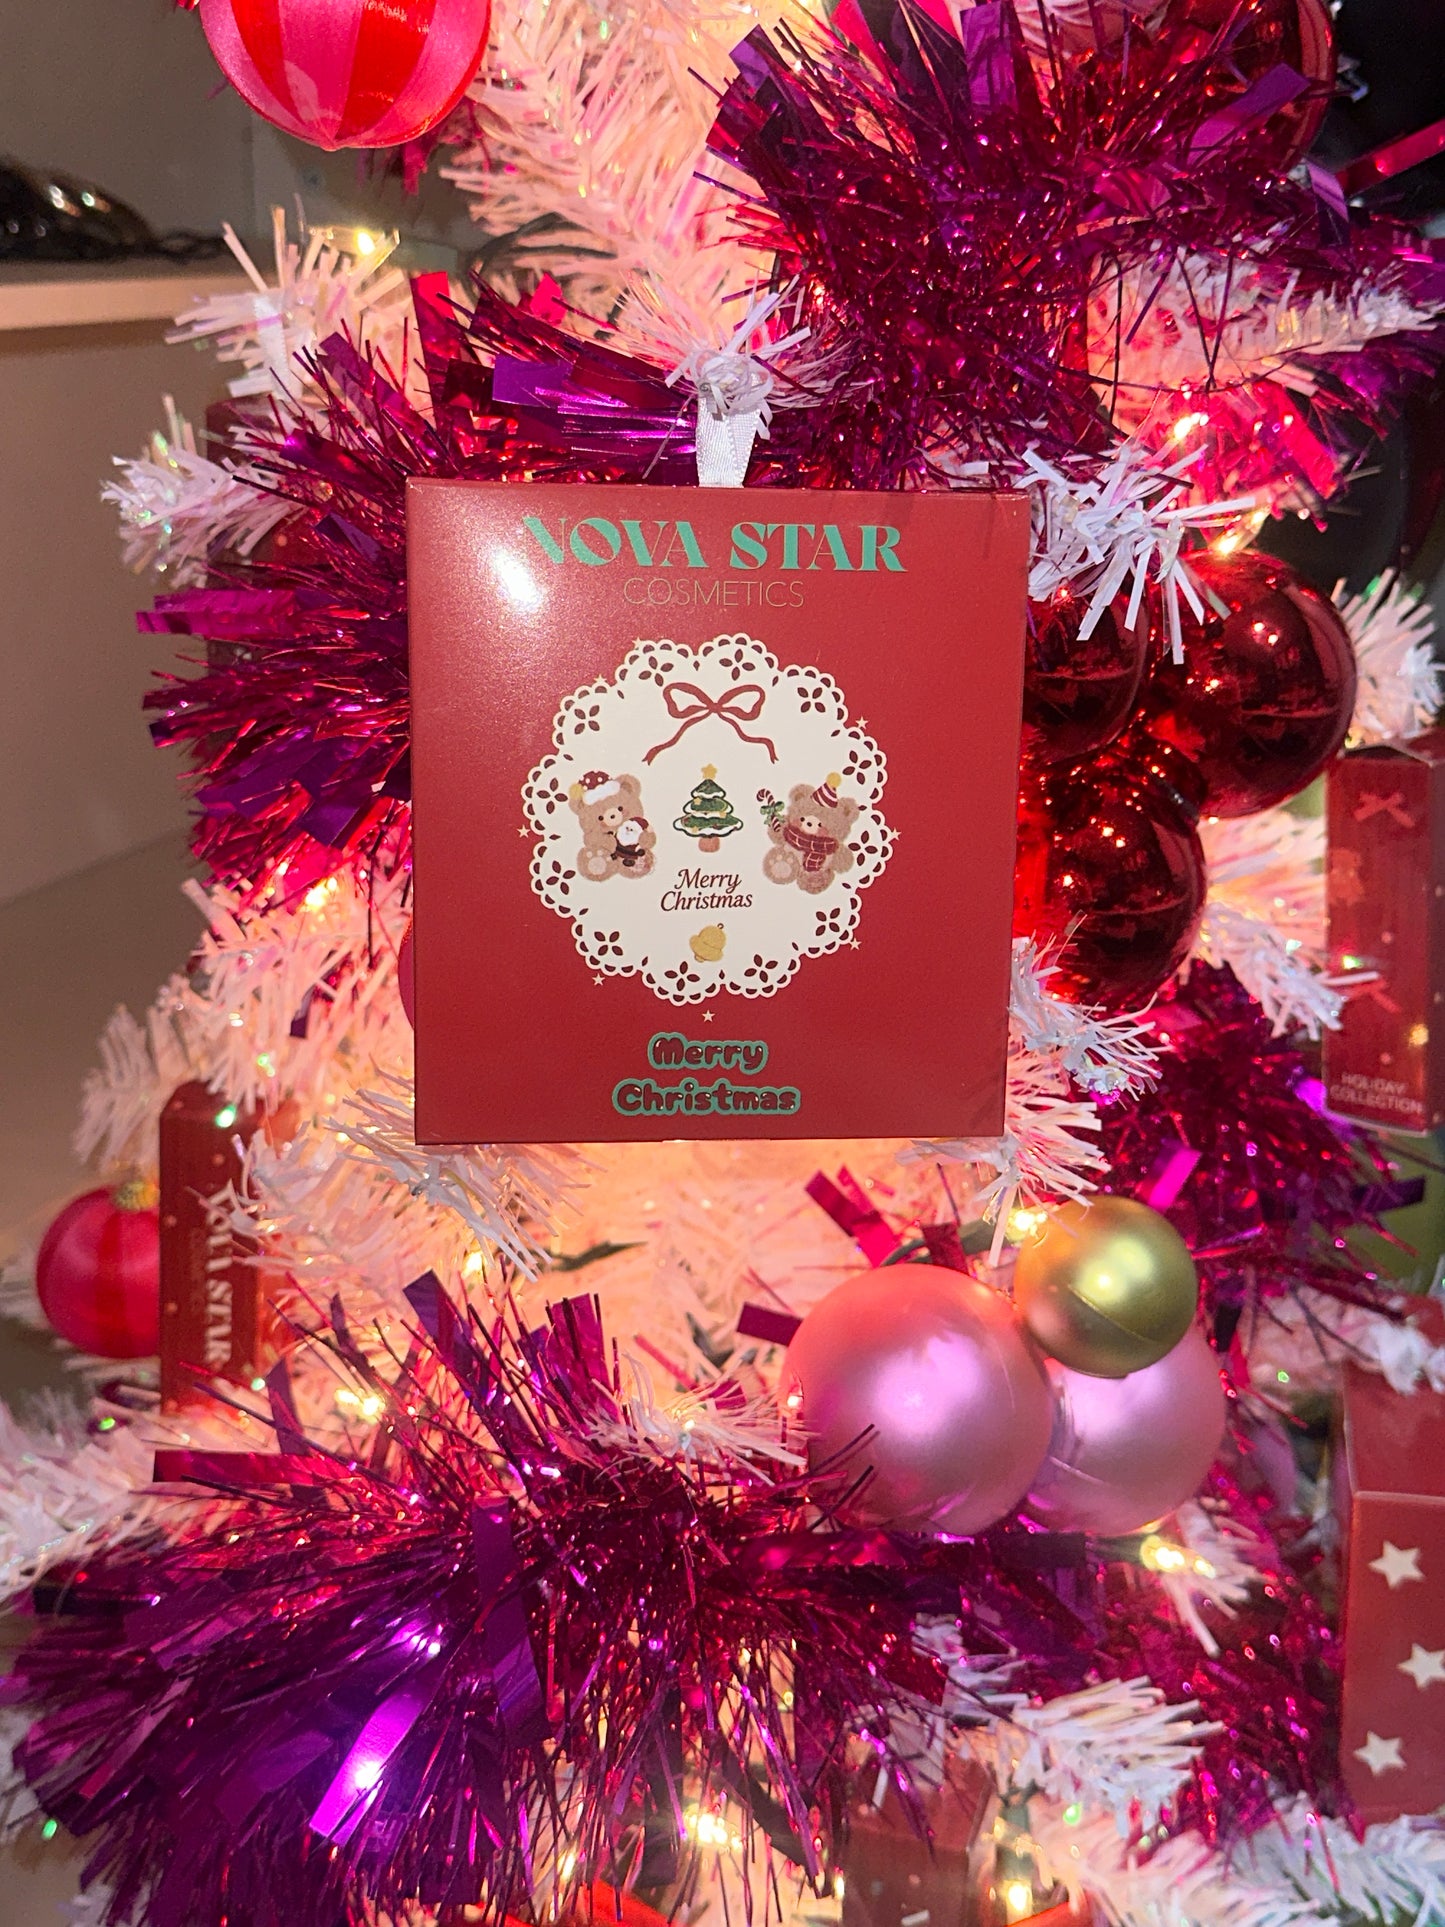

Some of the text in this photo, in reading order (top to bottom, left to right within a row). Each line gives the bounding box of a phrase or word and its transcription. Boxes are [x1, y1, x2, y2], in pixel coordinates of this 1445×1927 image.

[522, 516, 909, 572] NOVA STAR
[623, 577, 805, 608] COSMETICS
[674, 867, 742, 894] Merry
[660, 890, 753, 912] Christmas
[648, 1032, 769, 1075] Merry
[612, 1077, 801, 1116] Christmas
[1329, 1084, 1422, 1113] COLLECTION
[1341, 1072, 1406, 1095] HOLIDAY
